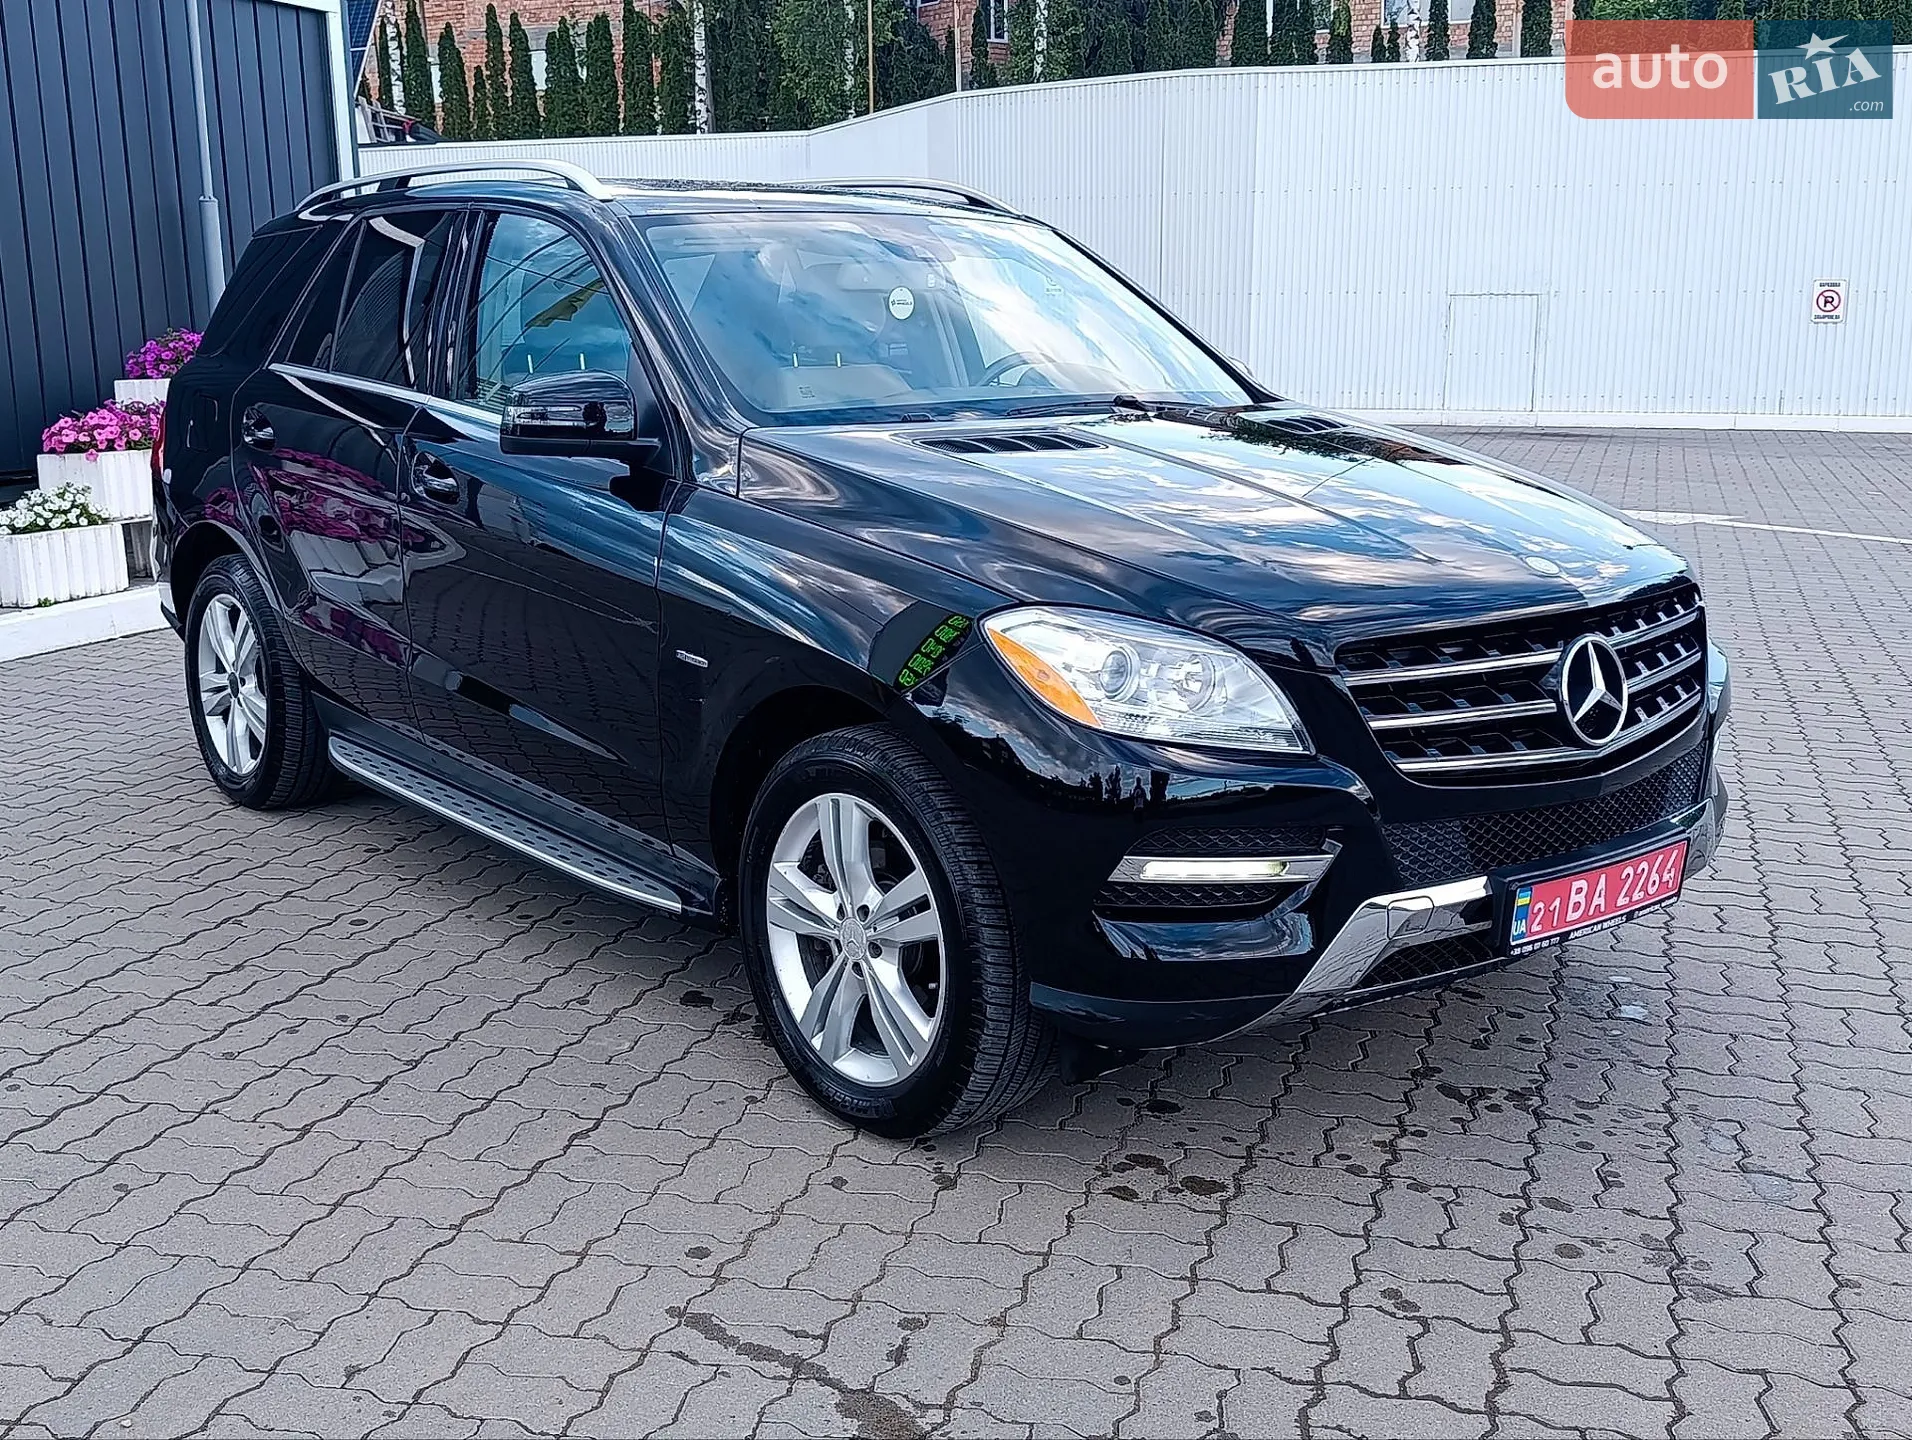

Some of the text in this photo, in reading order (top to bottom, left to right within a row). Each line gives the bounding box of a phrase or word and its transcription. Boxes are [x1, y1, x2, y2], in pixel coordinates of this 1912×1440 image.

[1530, 897, 1561, 933] 21
[1565, 873, 1606, 922] BA
[1616, 849, 1679, 907] 2264
[1512, 920, 1527, 936] UA
[1568, 915, 1627, 940] AMERICAN WHEELS
